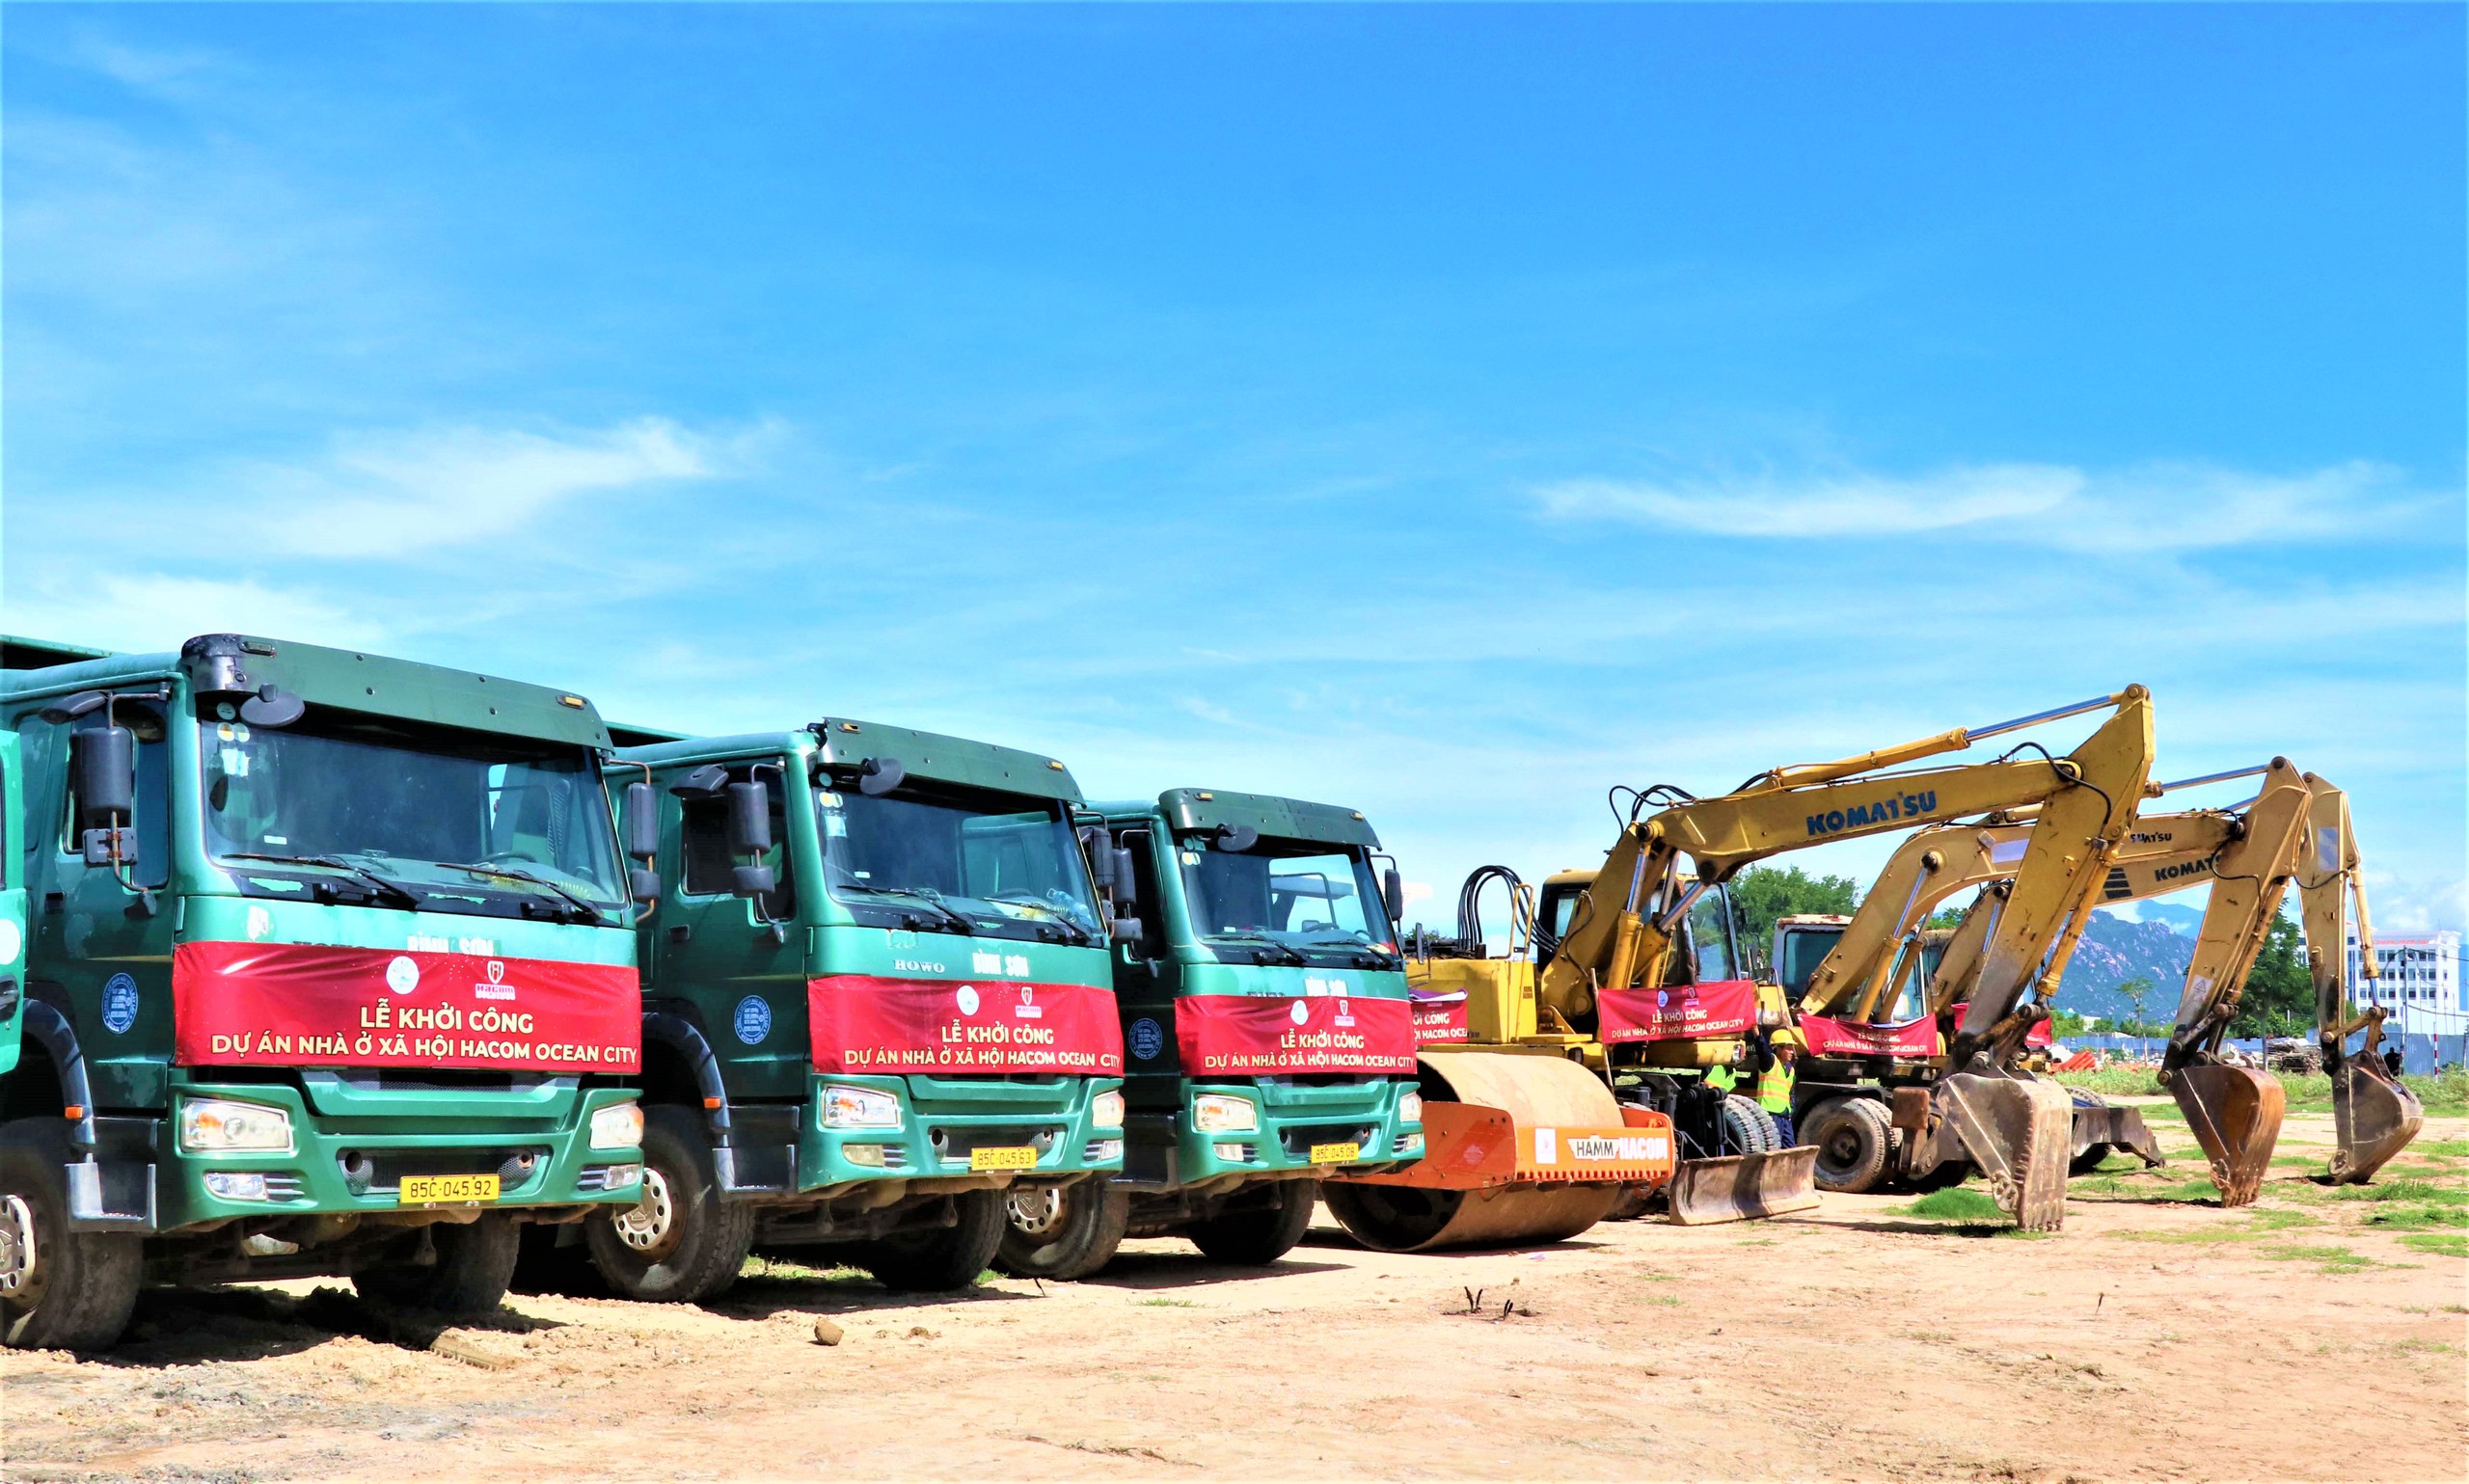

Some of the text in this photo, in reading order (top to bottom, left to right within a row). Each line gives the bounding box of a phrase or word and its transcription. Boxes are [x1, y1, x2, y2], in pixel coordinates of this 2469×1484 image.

[1806, 791, 1937, 836] KOMATSU
[2155, 856, 2218, 881] KOMAT
[894, 959, 945, 973] HOWO
[360, 997, 533, 1034] LỄ KHỞI CÔNG
[941, 1018, 1054, 1044] LỄ KHỞI CÔNG
[1281, 1028, 1365, 1049] LỄ KHỞI CÔNG
[211, 1030, 638, 1066] DỰ ÁN NHÀ Ở XÃ HỘI HACOM OCEAN CITY
[844, 1045, 1121, 1068] DỰ ÁN NHÀ Ở XÃ HỘI HACOM OCEAN CITY
[1205, 1050, 1414, 1070] DỰ ÁN NHÀ Ở XÃ HỘI HACOM OCEAN CITY
[1577, 1138, 1669, 1159] HAMM HACOM
